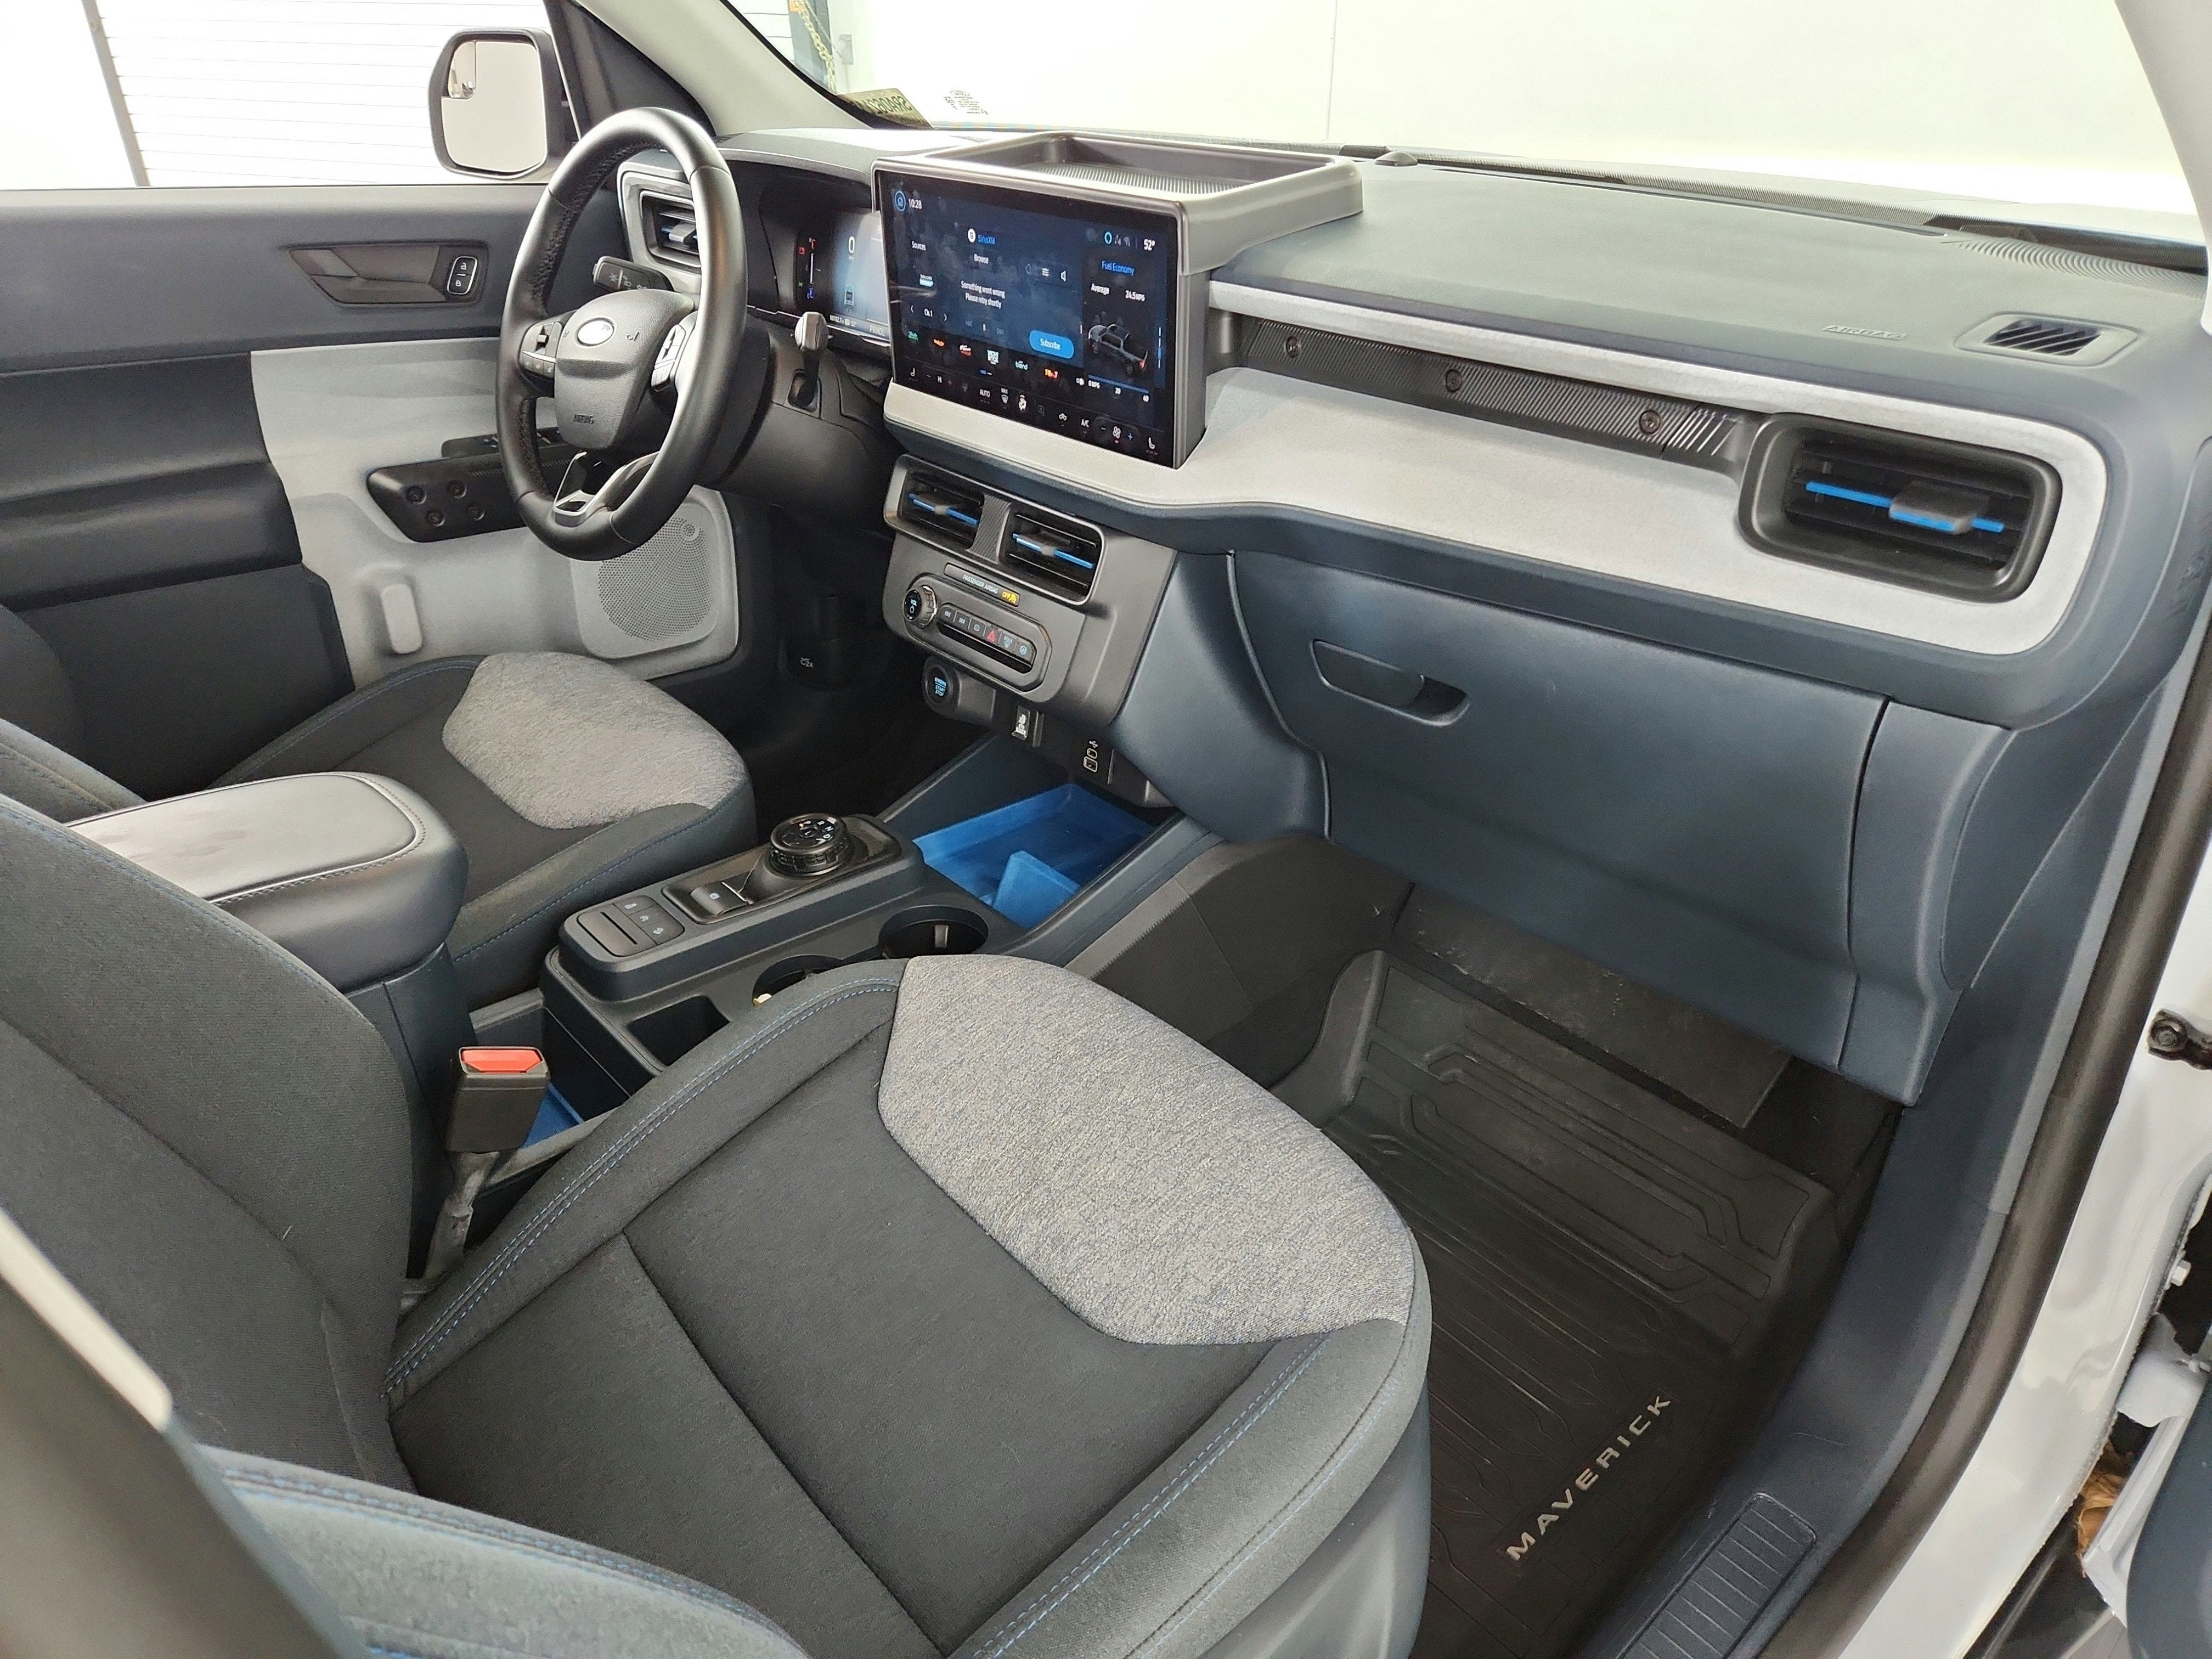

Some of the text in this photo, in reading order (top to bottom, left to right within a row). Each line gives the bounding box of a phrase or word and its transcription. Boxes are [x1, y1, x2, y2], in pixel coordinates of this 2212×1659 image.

[908, 198, 922, 209] 10:28
[849, 236, 855, 254] 0
[911, 240, 926, 251] Sources
[974, 253, 989, 264] Browse
[1102, 261, 1135, 276] Fuel Economy
[961, 280, 982, 294] Something
[992, 289, 1005, 299] wrong
[1091, 283, 1110, 295] Average
[965, 292, 978, 303] Please
[1825, 326, 1904, 339] AIRBAG
[1040, 338, 1060, 350] Subscribe
[980, 388, 990, 397] AUTO
[963, 574, 985, 588] PASSENGER
[984, 584, 998, 594] AIRBAG
[1003, 635, 1013, 644] MAX
[1506, 1396, 1671, 1561] MAVERICK
